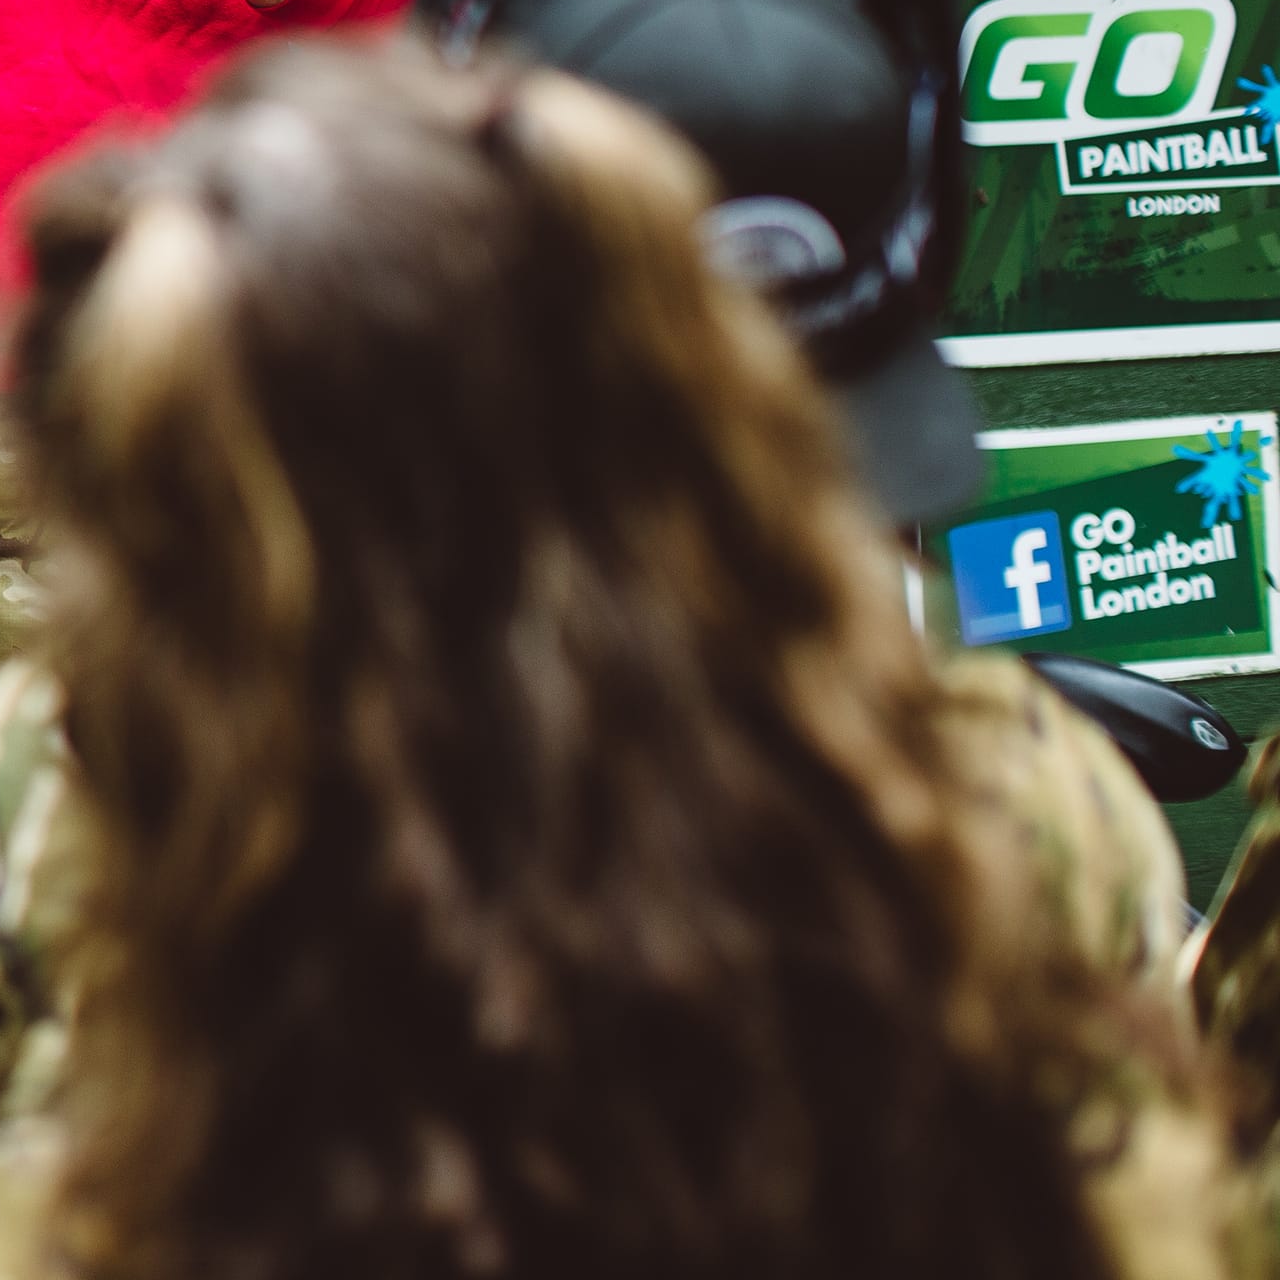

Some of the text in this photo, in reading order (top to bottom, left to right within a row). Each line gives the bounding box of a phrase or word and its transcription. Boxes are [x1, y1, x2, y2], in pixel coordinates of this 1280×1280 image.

[960, 1, 1223, 125] GO
[1078, 124, 1268, 179] PAINTBALL
[1127, 194, 1221, 218] LONDON
[1070, 506, 1136, 551] GO
[1075, 521, 1237, 588] Paintball
[1078, 571, 1217, 621] London
